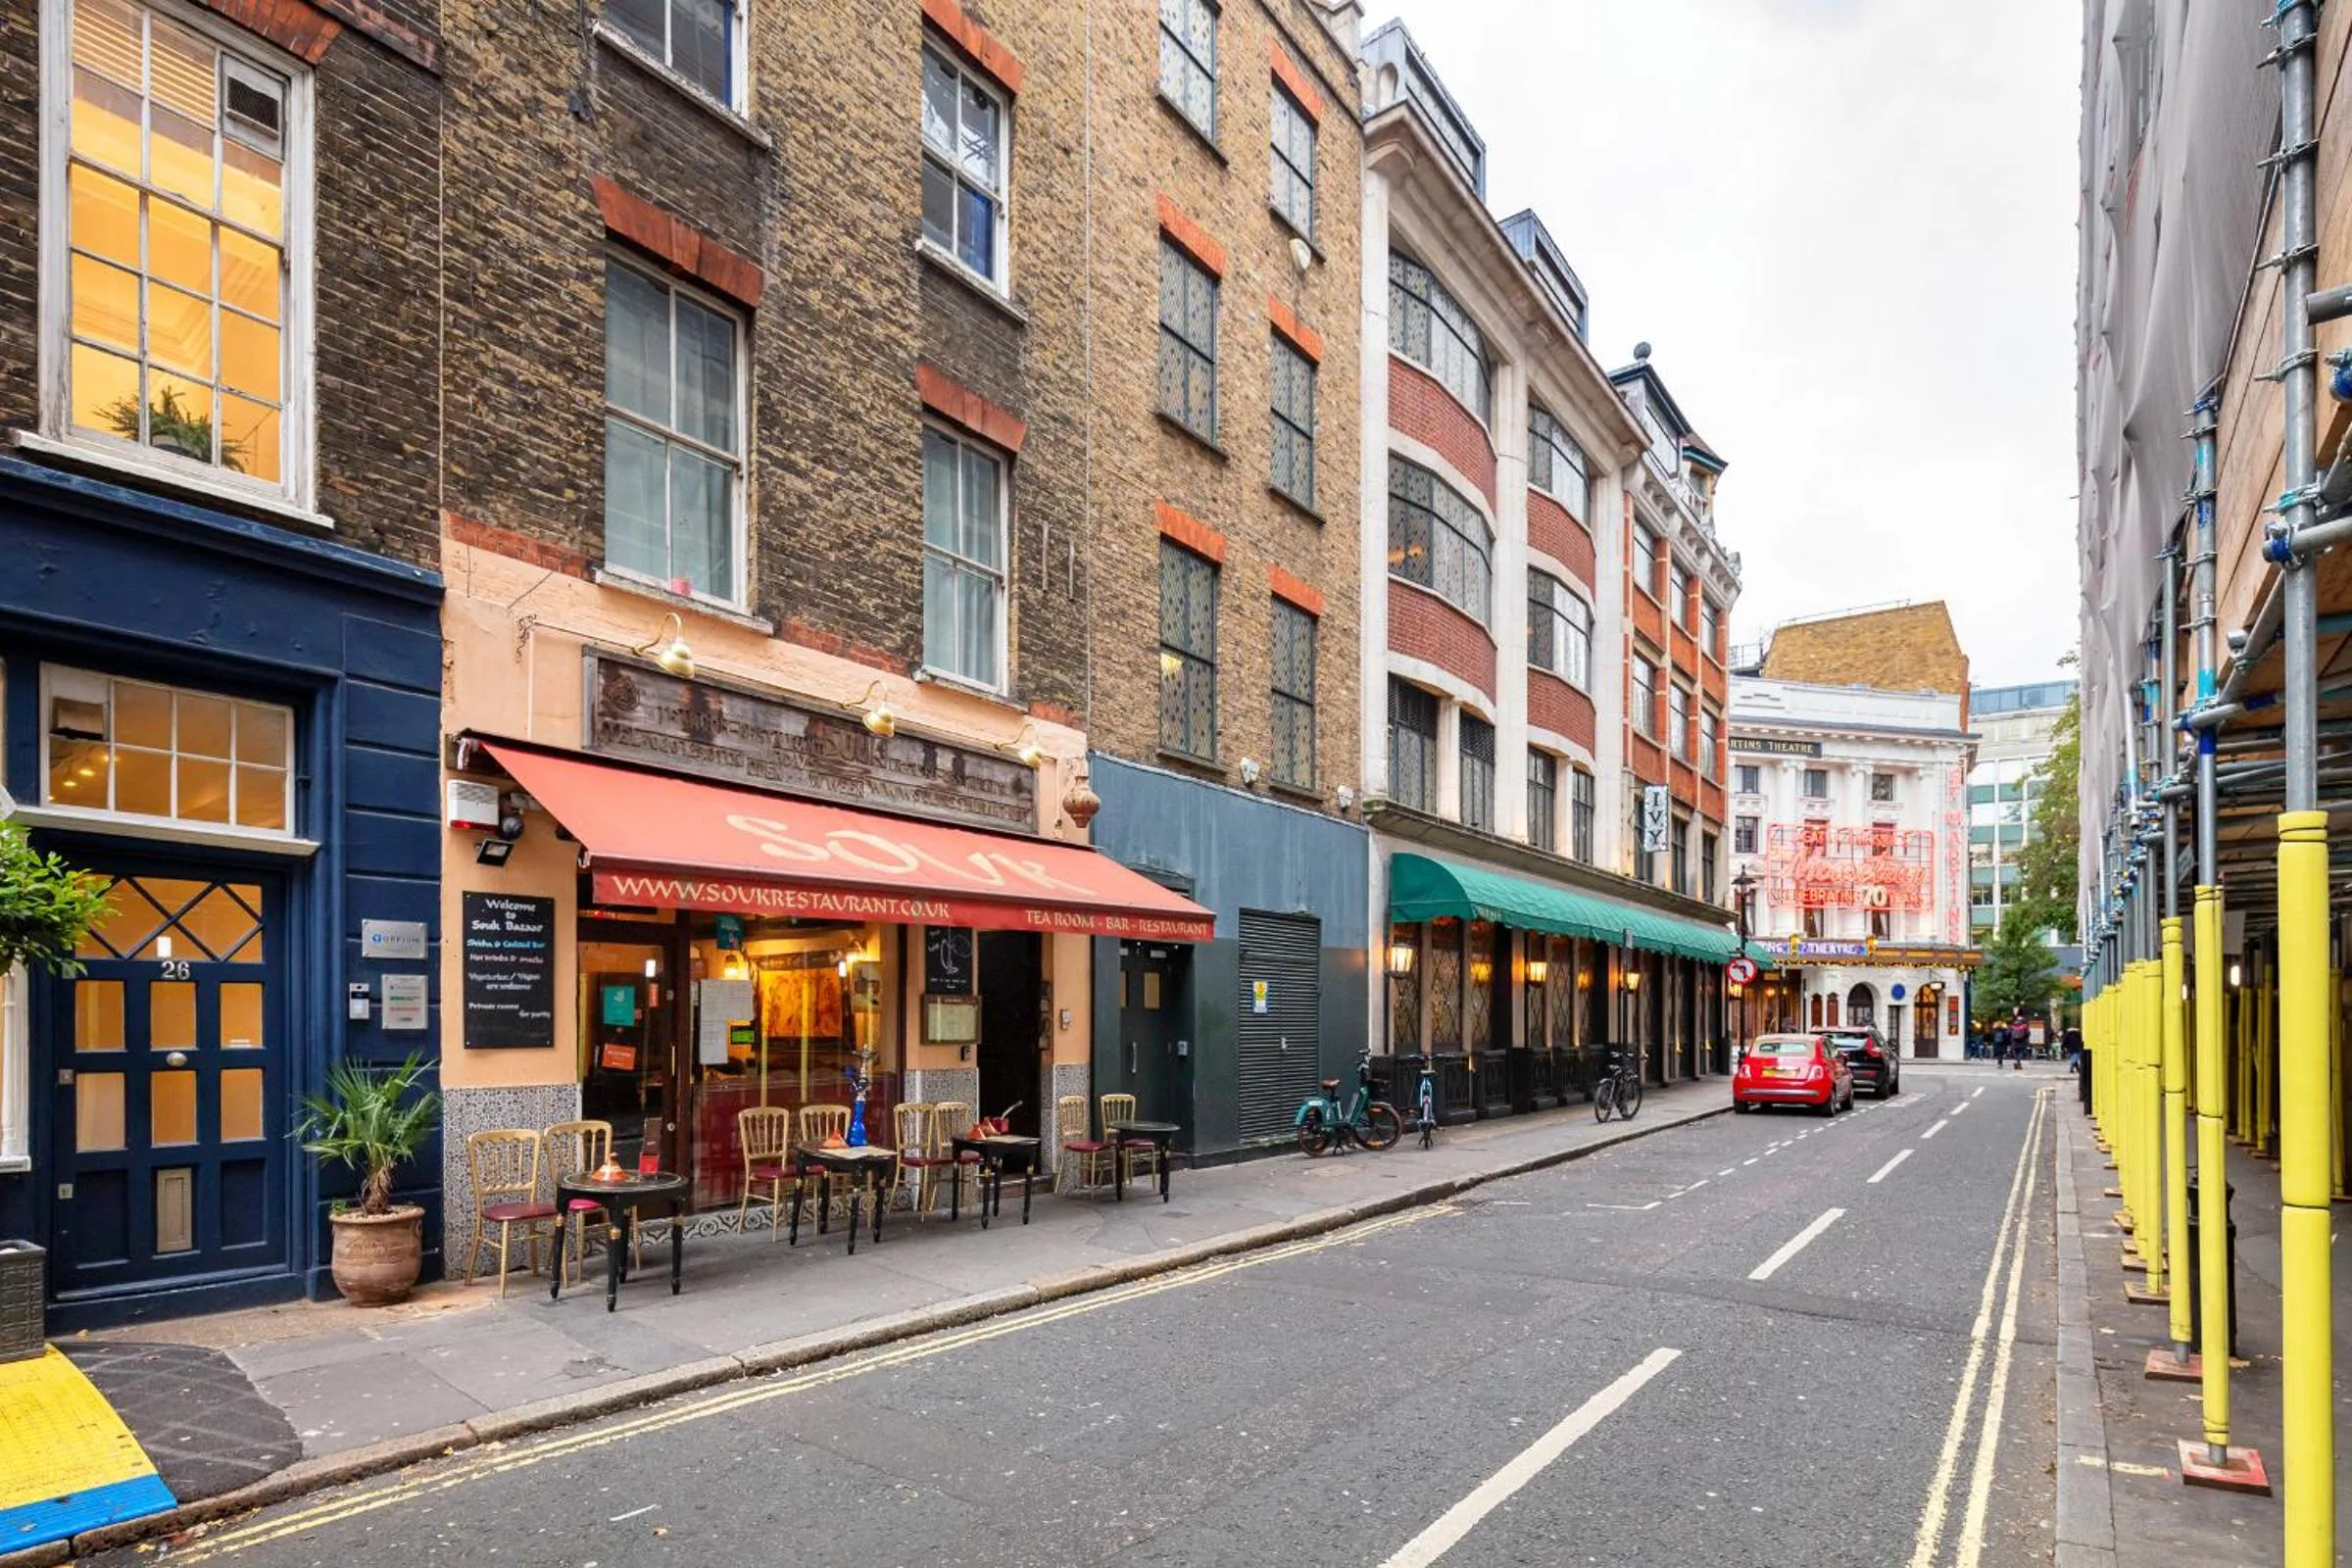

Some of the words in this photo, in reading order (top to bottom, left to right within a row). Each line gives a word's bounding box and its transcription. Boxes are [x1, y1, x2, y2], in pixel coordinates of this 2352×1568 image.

[1730, 739, 1761, 751] RTINS
[1768, 741, 1814, 754] THEATRE
[1647, 791, 1664, 844] IVY
[726, 814, 1097, 897] SOUK
[485, 898, 536, 912] Welcome
[612, 875, 951, 918] WWW.SOUKRESTAURANT.CO.UK
[1862, 885, 1887, 906] 70
[505, 910, 516, 920] to
[1025, 909, 1052, 925] TEA
[1054, 912, 1095, 929] ROOM
[1105, 916, 1130, 931] BAR
[1139, 918, 1208, 935] RESTAURANT
[471, 919, 501, 931] Souk
[505, 920, 544, 933] Bazaar
[1808, 942, 1857, 955] THEATRE
[161, 960, 191, 980] 26
